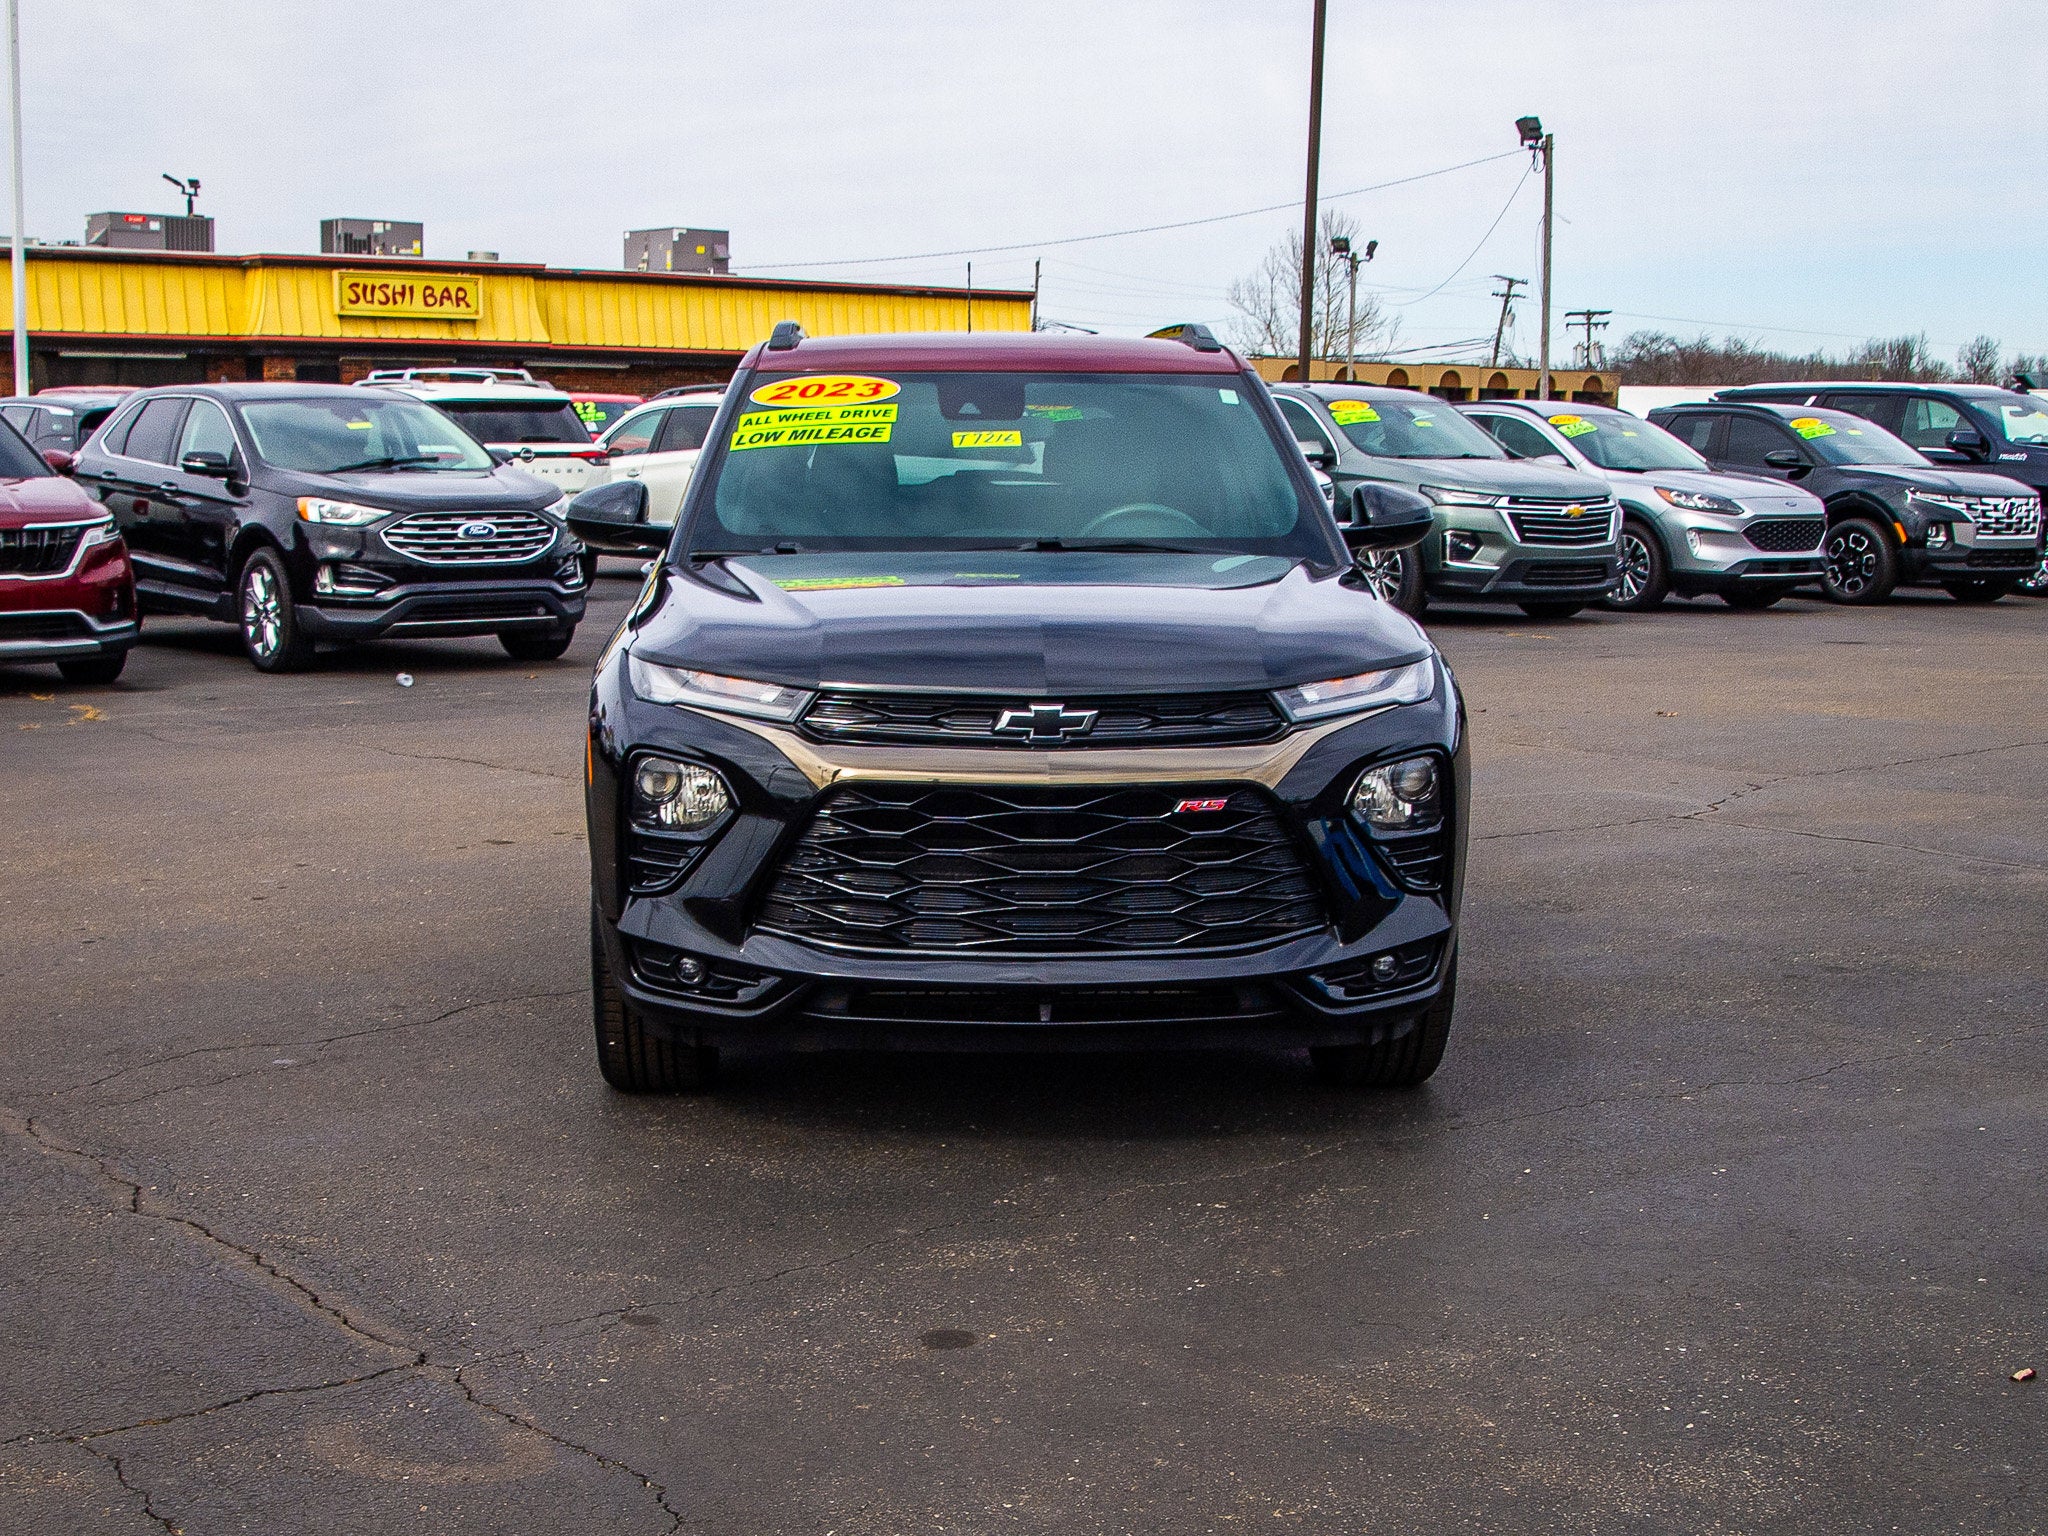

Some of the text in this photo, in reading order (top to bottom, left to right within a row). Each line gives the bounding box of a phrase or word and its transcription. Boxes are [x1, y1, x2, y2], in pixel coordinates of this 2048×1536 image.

[348, 282, 471, 308] SUSHI BAR
[766, 382, 884, 401] 2023
[743, 409, 893, 427] ALL WHEEL DRIVE
[735, 427, 886, 446] LOW MILEAGE
[1174, 799, 1228, 812] RS
